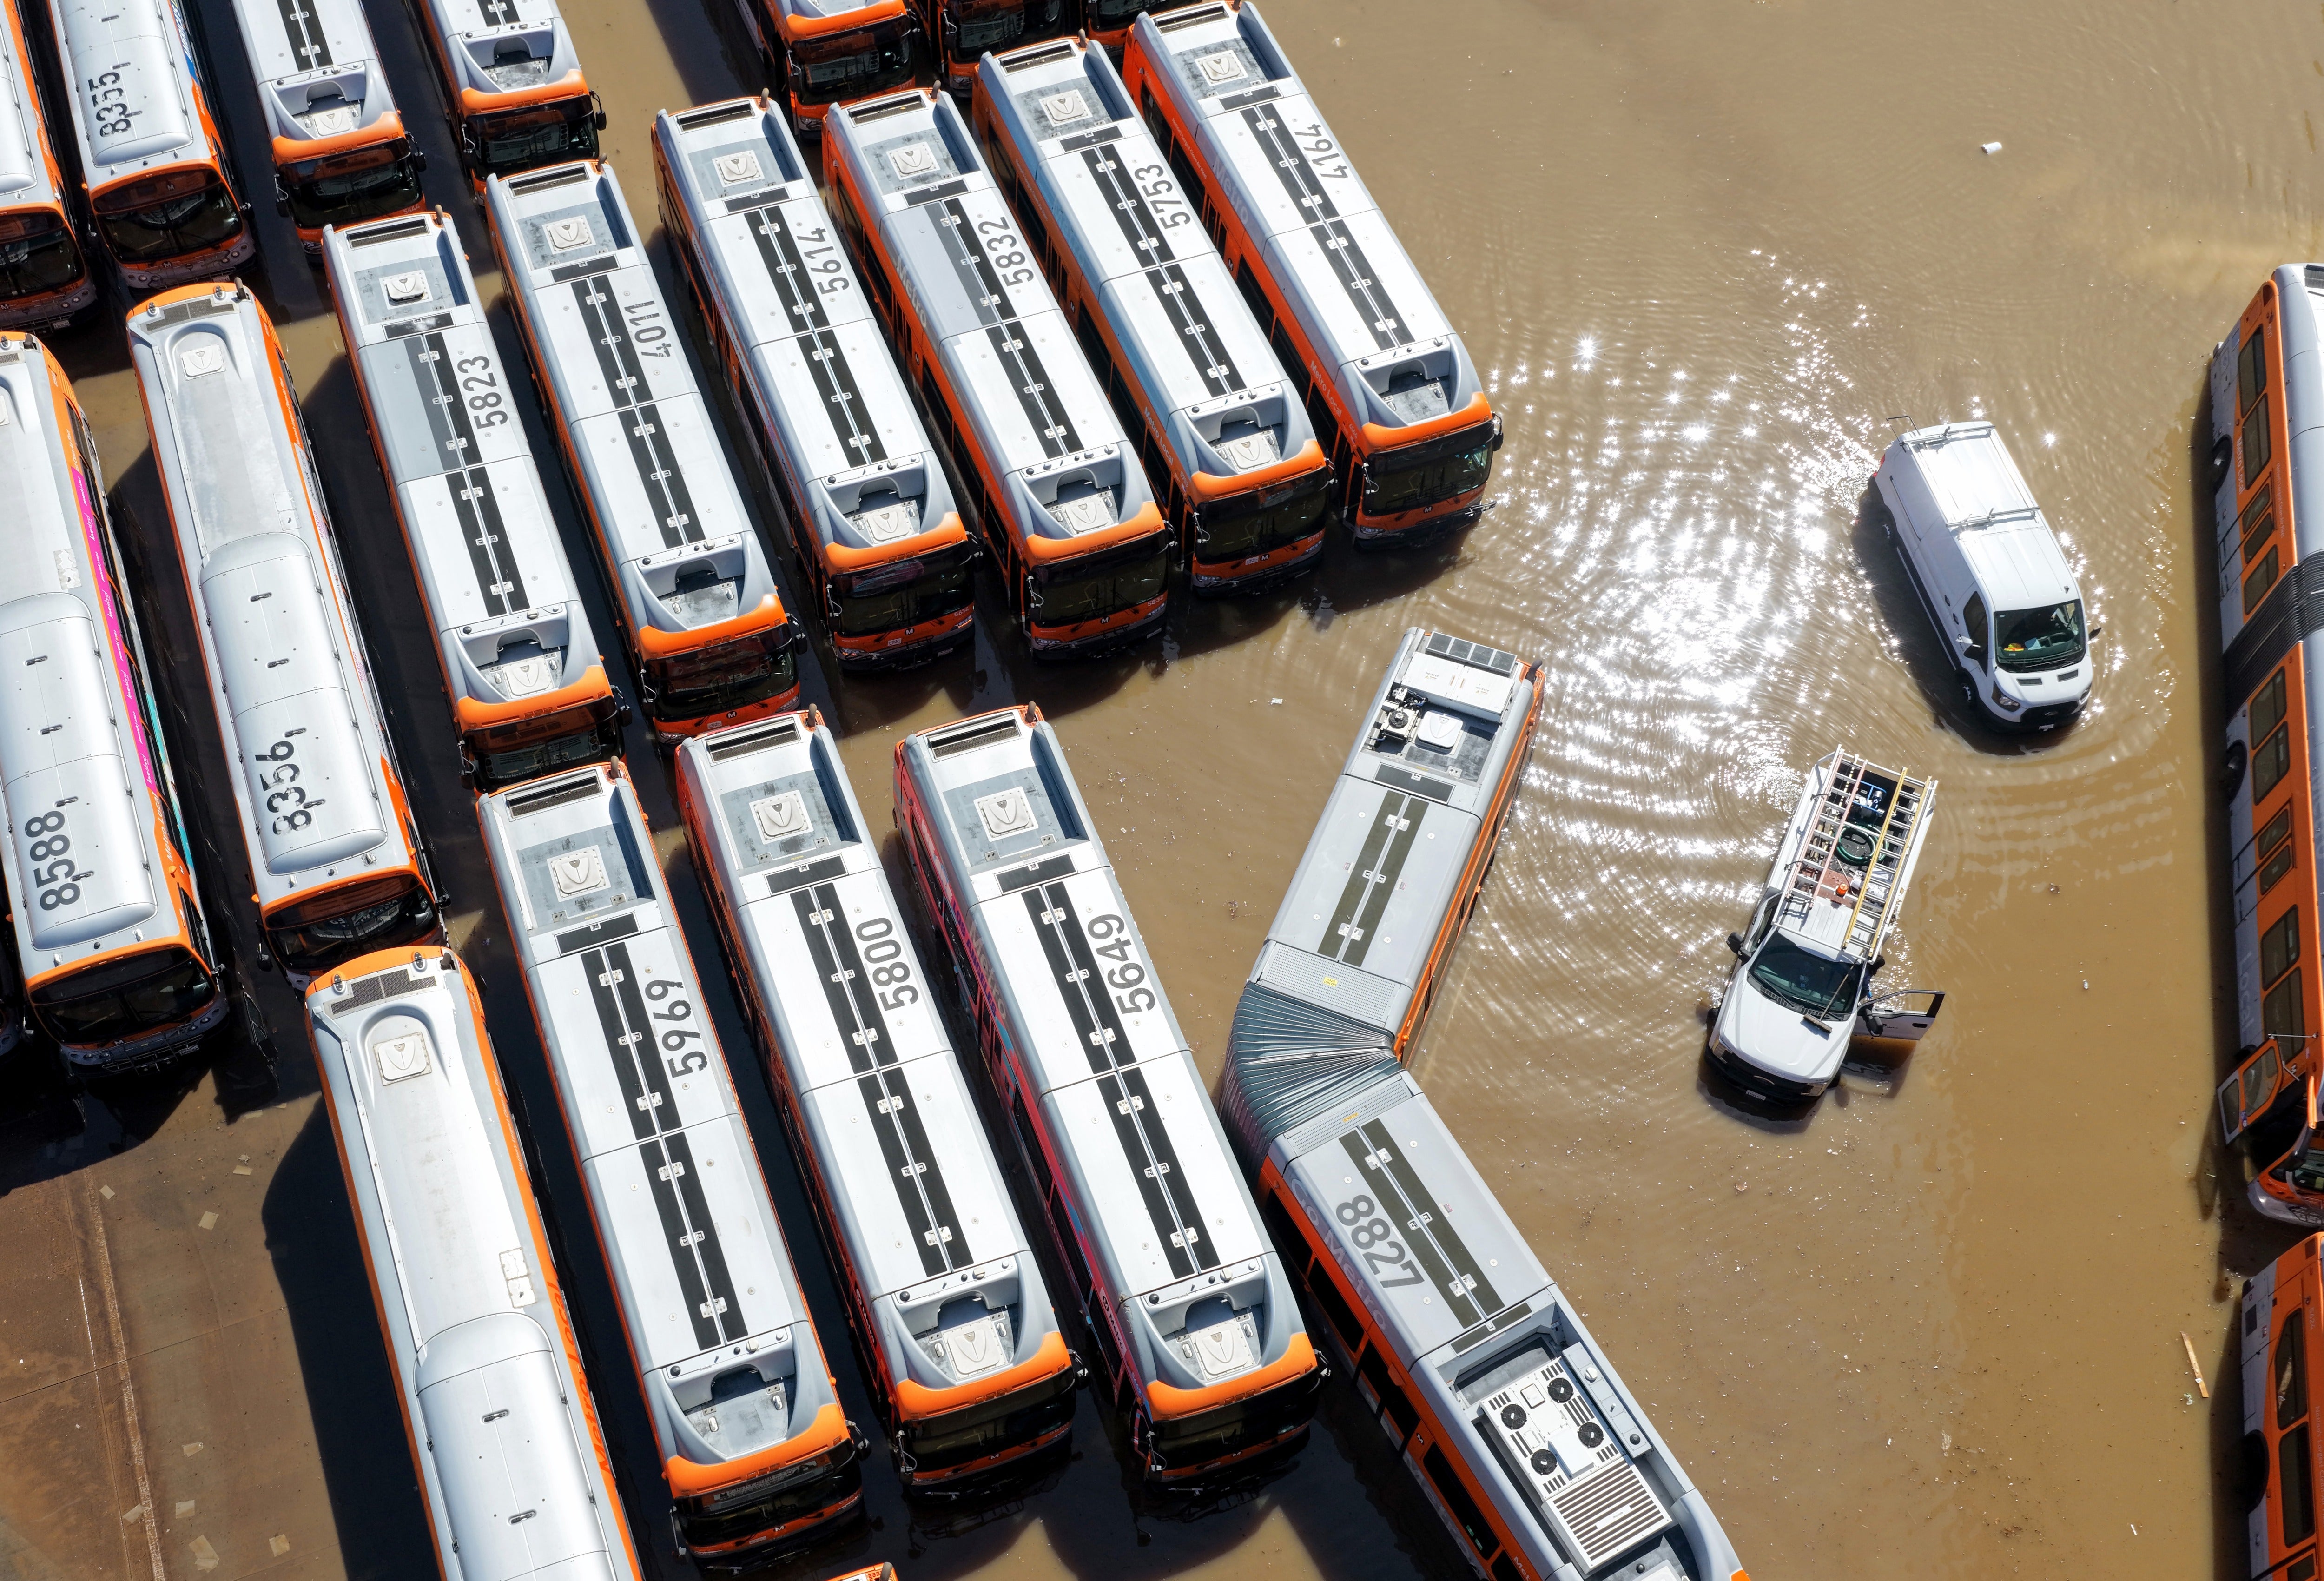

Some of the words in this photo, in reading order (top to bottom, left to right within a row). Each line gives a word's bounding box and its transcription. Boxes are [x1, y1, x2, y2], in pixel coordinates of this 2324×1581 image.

[90, 71, 131, 138] 8355
[898, 80, 912, 91] 3977
[1294, 123, 1348, 181] 4164
[403, 205, 420, 214] 5644
[1135, 164, 1191, 231] 5753
[797, 227, 849, 295] 5614
[977, 216, 1034, 288] 5832
[624, 300, 671, 361] 4011
[457, 356, 508, 430] 5823
[1310, 360, 1326, 393] Metro
[1326, 390, 1342, 417] Local
[1144, 406, 1159, 435] Metro
[1159, 433, 1174, 466] Local
[344, 615, 354, 639] Expect
[954, 608, 969, 617] 5614
[1148, 595, 1163, 607] 5832
[779, 689, 794, 699] 4011
[153, 791, 164, 825] Local
[255, 741, 312, 836] 8356
[25, 810, 81, 911] 8588
[163, 826, 173, 862] Metro
[857, 917, 918, 1012] 5800
[951, 900, 966, 938] LOS
[966, 940, 997, 1018] ANGELES
[967, 919, 1006, 1020] Metro
[1089, 914, 1155, 1015] 5649
[645, 979, 709, 1078] 5969
[492, 1070, 500, 1087] Fleet
[505, 1117, 515, 1141] Largest
[513, 1142, 524, 1173] Nation's
[1290, 1177, 1320, 1226] Go
[1323, 1227, 1386, 1330] Metro
[1335, 1195, 1424, 1289] 8827
[862, 1307, 875, 1343] Metro
[1109, 1314, 1123, 1349] Metro
[1417, 1434, 1424, 1444] M
